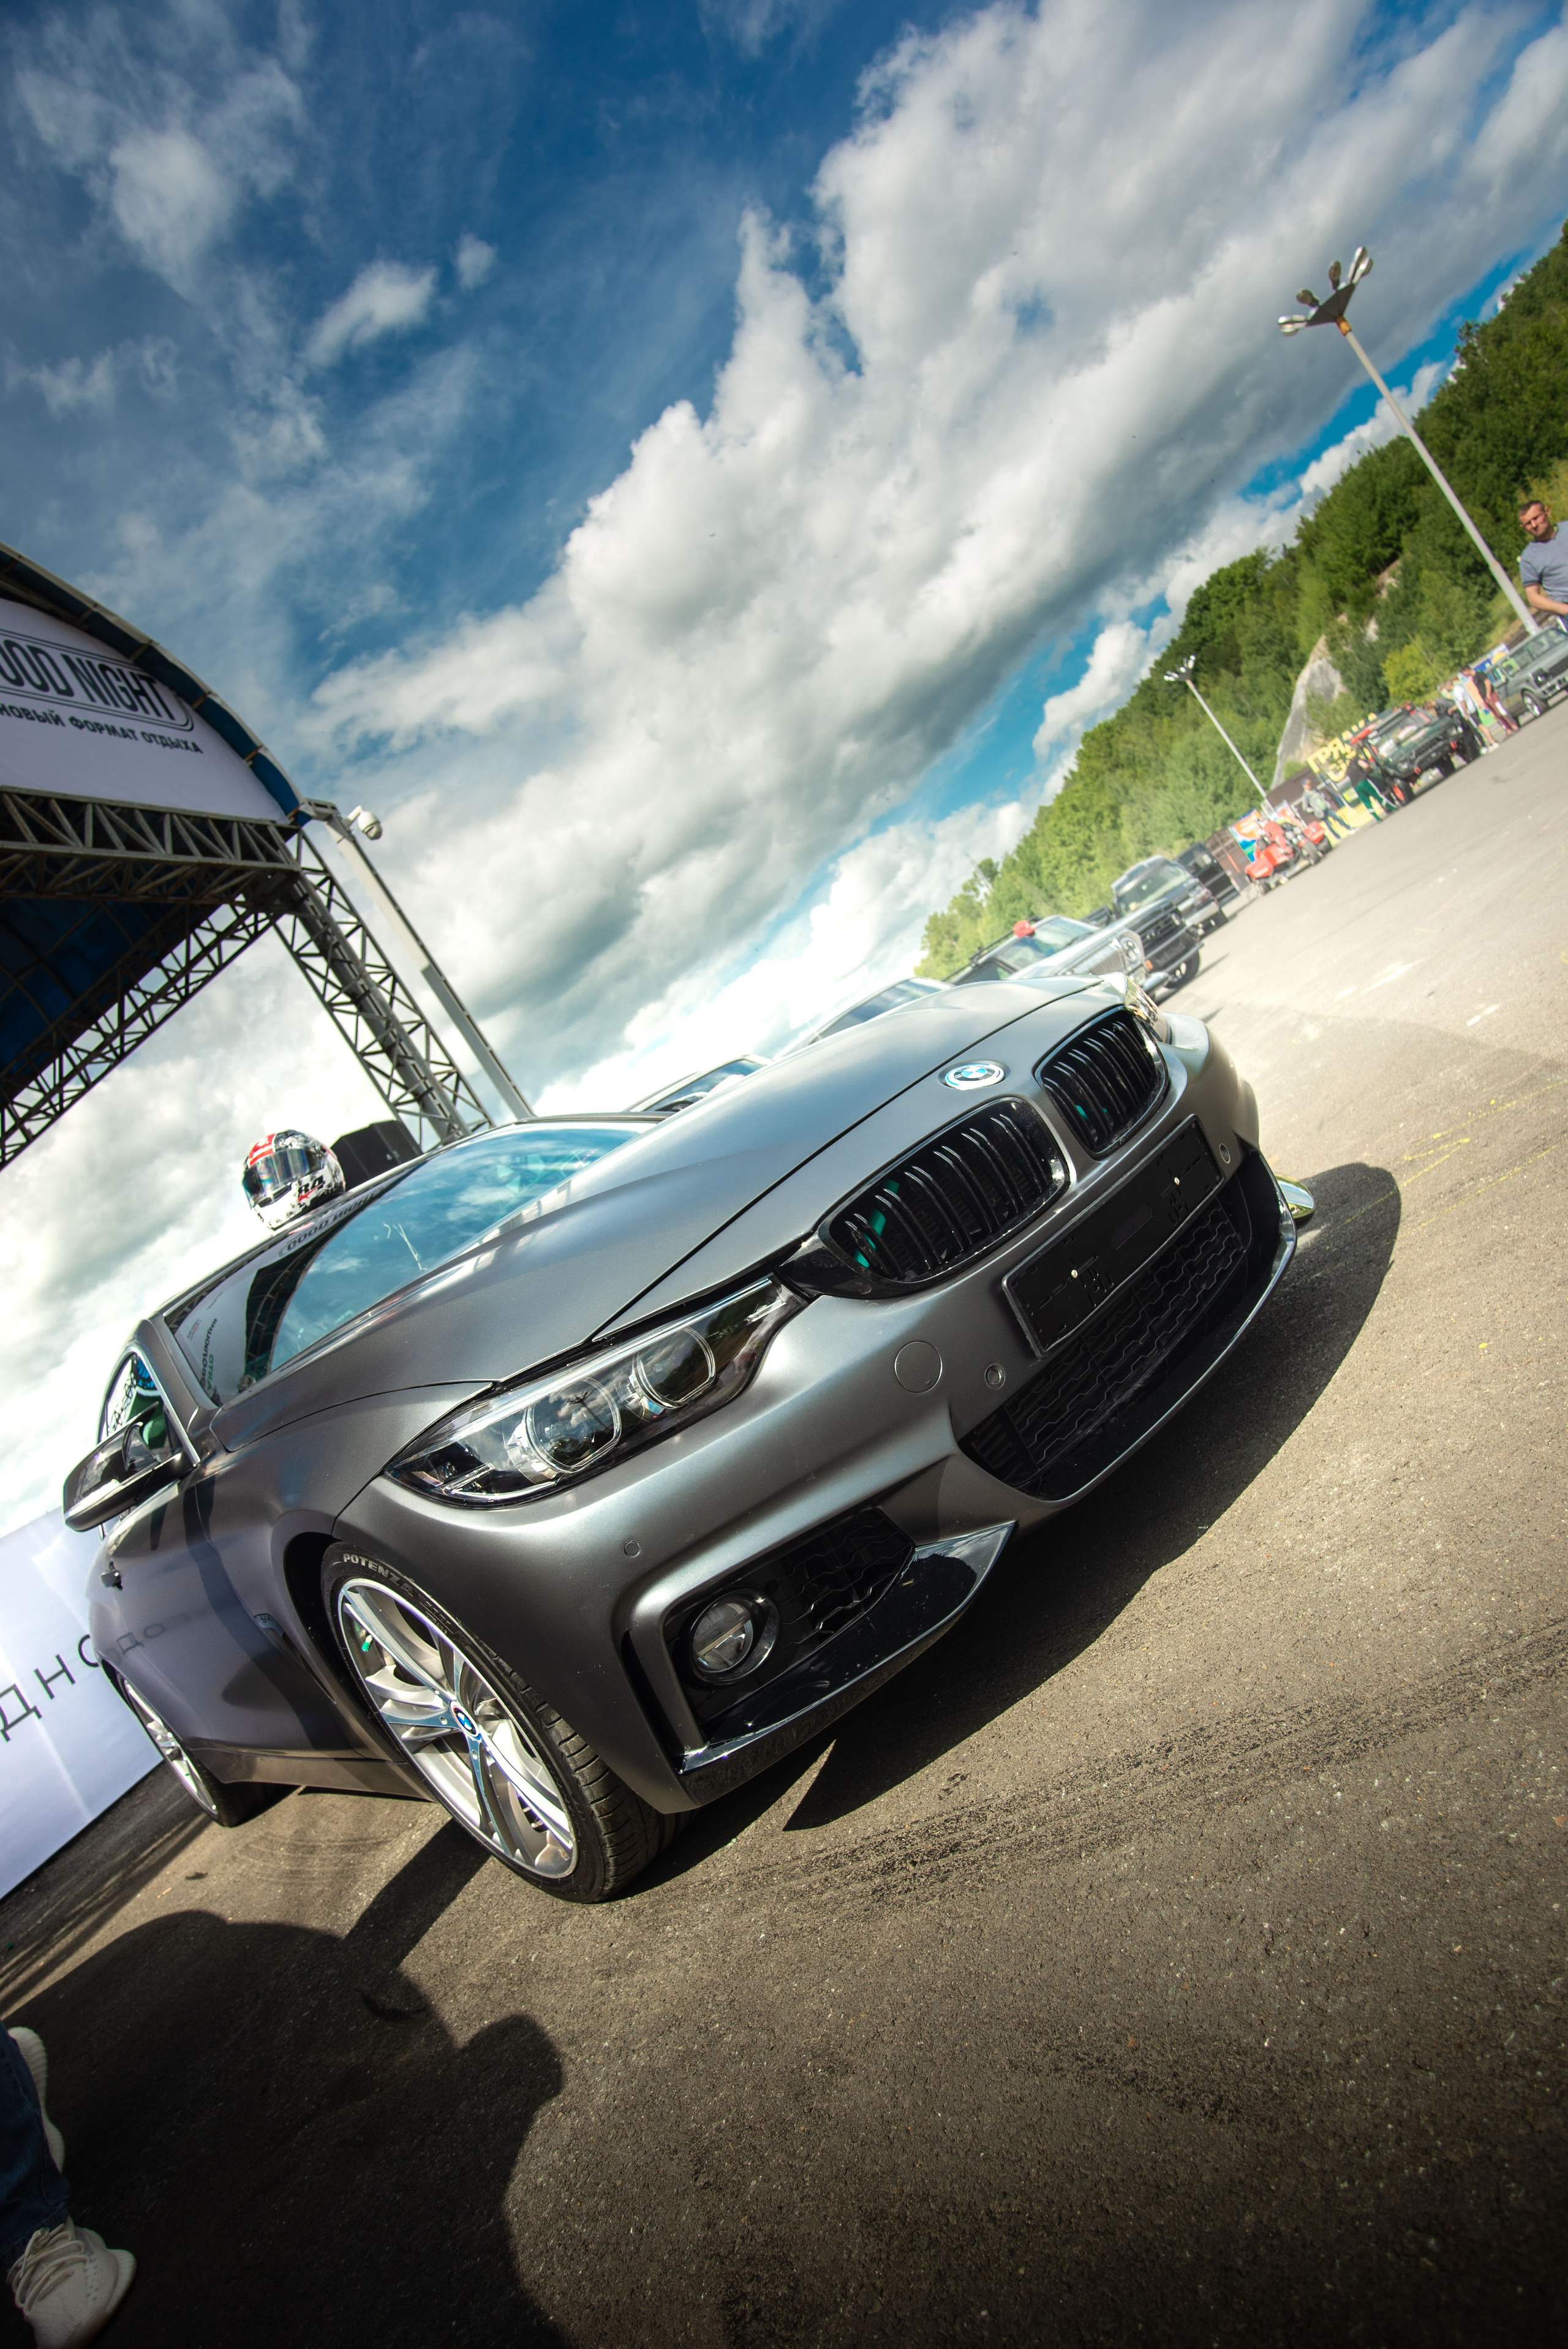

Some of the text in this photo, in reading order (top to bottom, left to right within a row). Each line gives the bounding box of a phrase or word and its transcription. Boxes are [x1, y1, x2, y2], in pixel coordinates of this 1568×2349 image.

[60, 653, 176, 720] NIGHT
[68, 715, 138, 741] ФОРМАТ
[140, 731, 203, 753] ОТДЫХА
[342, 1552, 414, 1597] POTENZA
